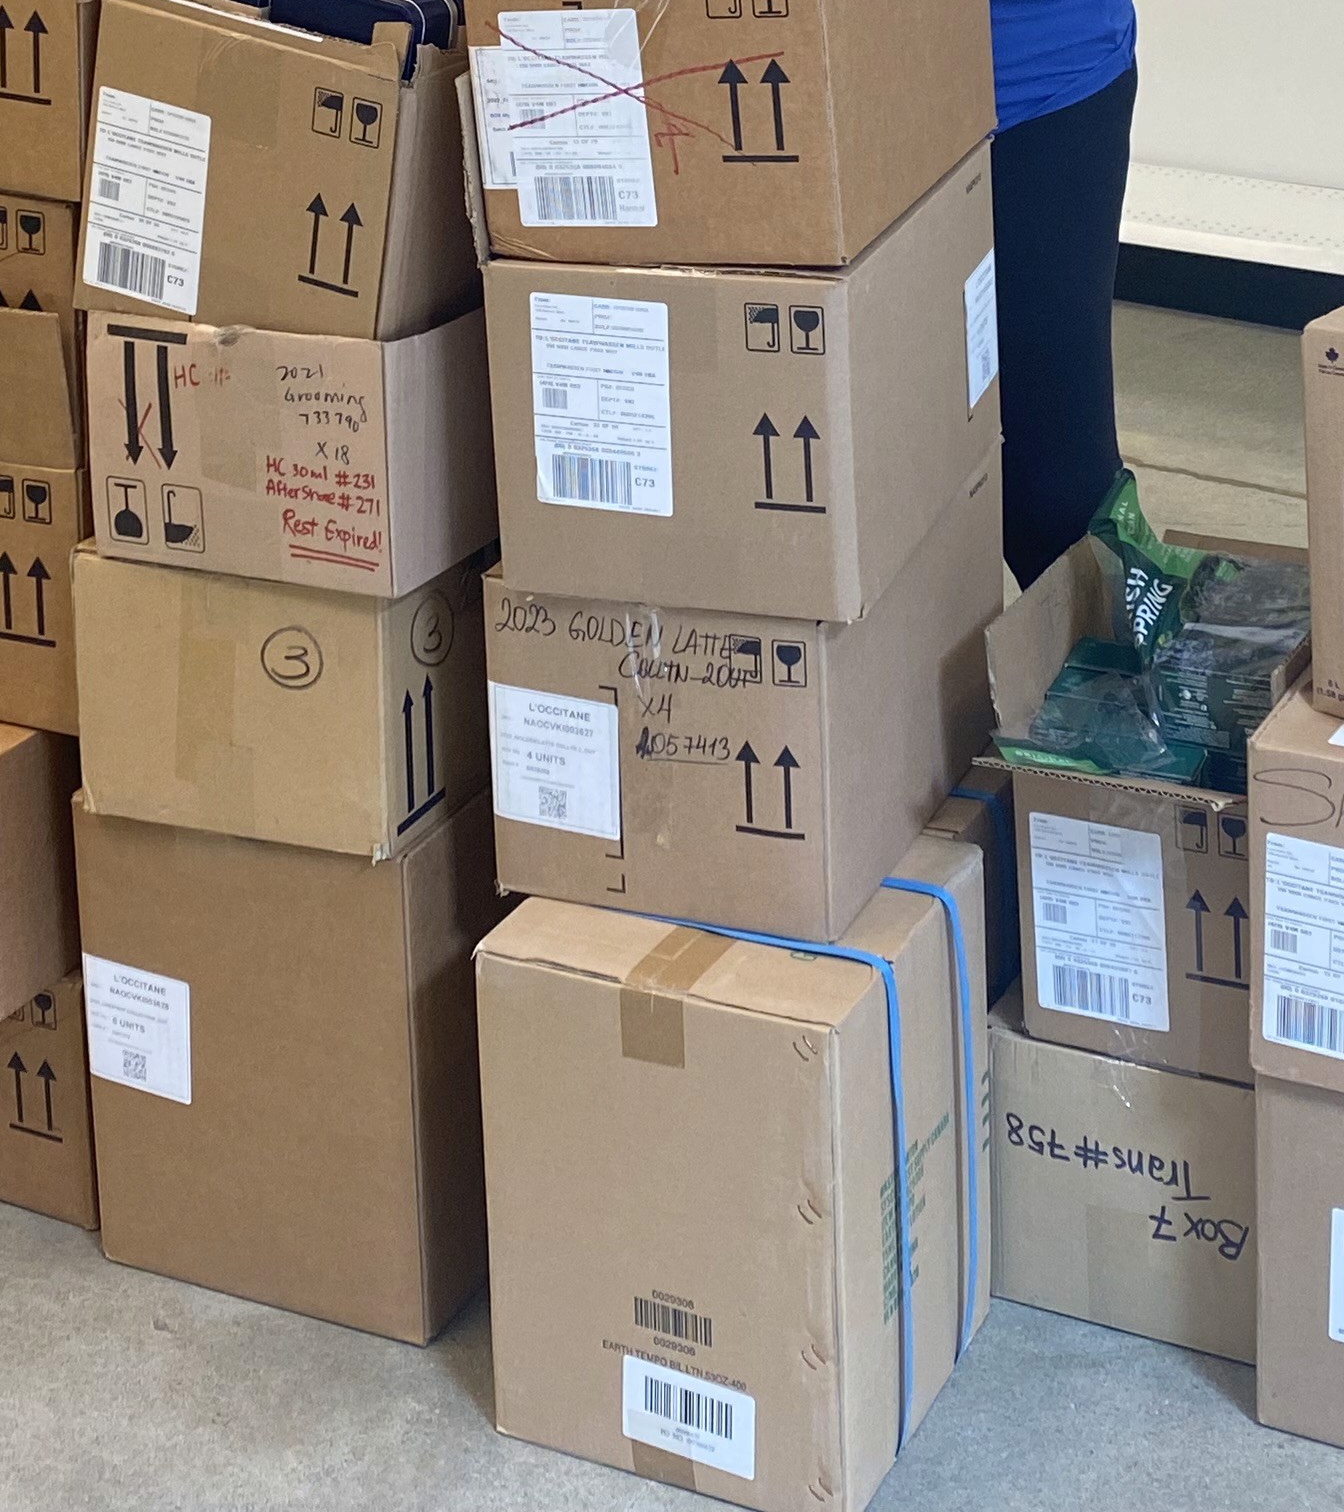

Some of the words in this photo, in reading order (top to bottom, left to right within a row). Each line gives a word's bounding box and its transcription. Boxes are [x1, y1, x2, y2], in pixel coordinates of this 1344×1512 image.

[618, 190, 639, 201] C73
[167, 275, 184, 287] C73
[174, 364, 200, 388] HC
[276, 364, 324, 381] 2021
[284, 385, 367, 422] Grooming
[266, 455, 285, 477] HC
[635, 477, 655, 488] C73
[282, 508, 319, 538] Rest
[325, 519, 383, 554] Expired!
[495, 598, 556, 636] 2023
[568, 611, 663, 648] GOLDEN
[672, 624, 734, 660] LATTE
[529, 702, 591, 722] L'OCCITANE
[526, 751, 533, 759] 4
[535, 752, 566, 766] UNITS
[113, 973, 167, 997] L'OCCITANE
[1132, 993, 1152, 1006] C73
[120, 1019, 145, 1034] UNITS
[1149, 1205, 1177, 1242] 7
[1183, 1212, 1249, 1261] Box
[603, 1339, 633, 1356] EARTH
[635, 1349, 667, 1368] TEMPO
